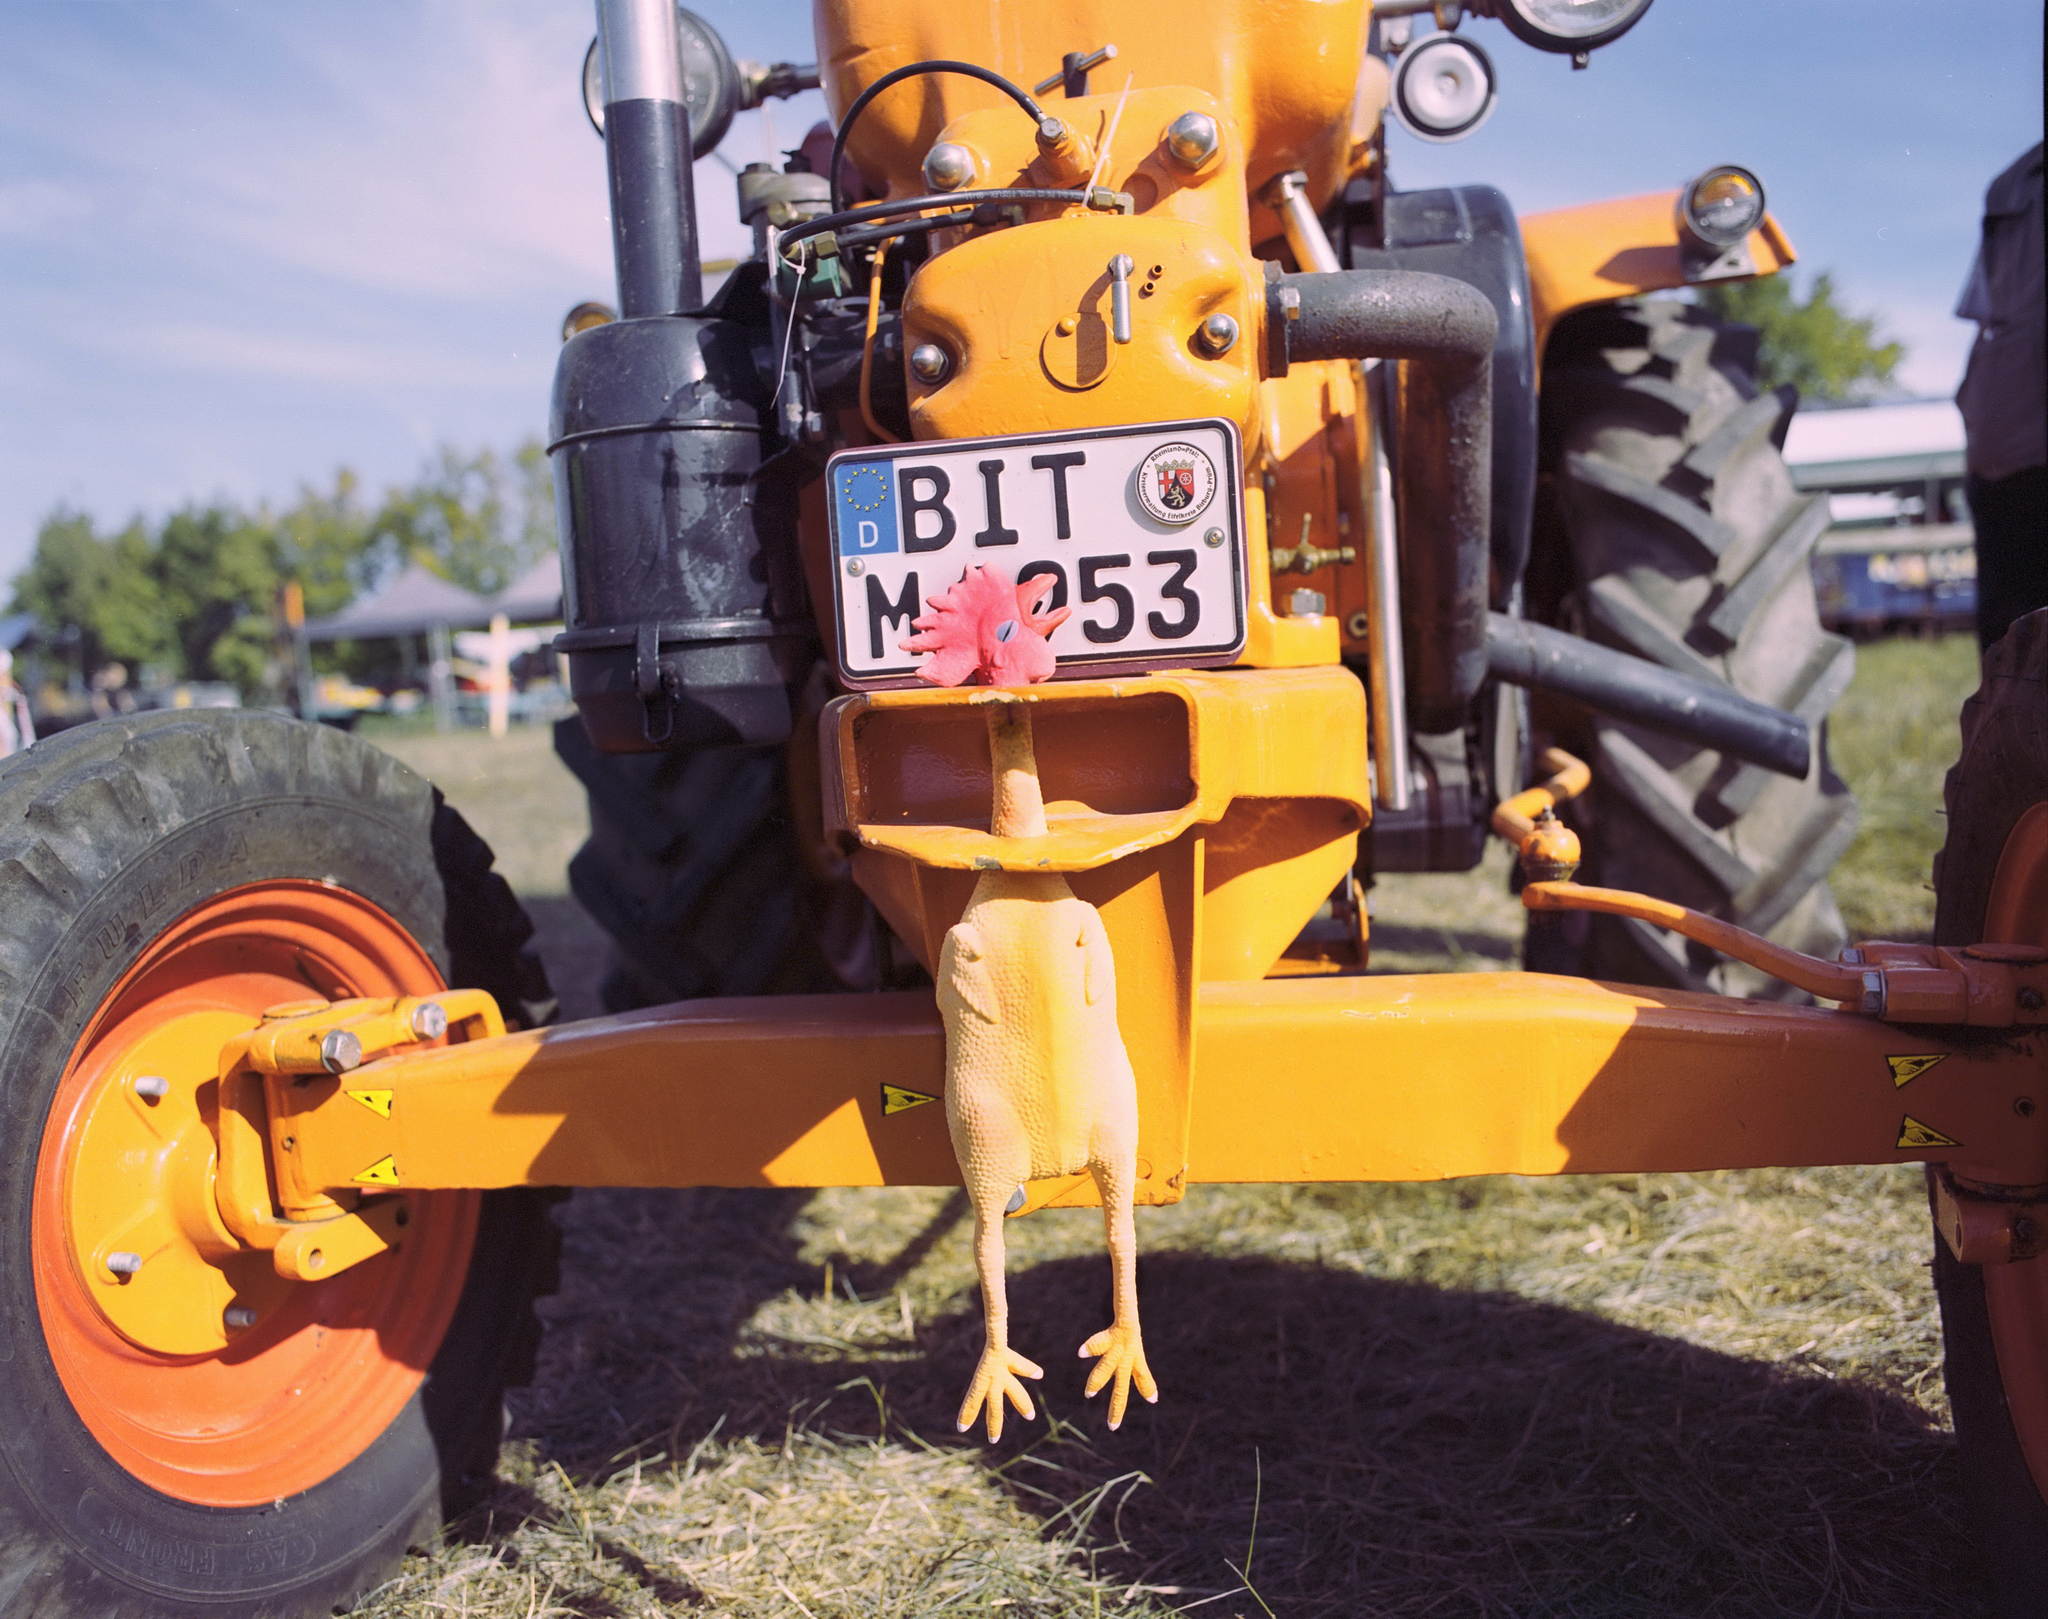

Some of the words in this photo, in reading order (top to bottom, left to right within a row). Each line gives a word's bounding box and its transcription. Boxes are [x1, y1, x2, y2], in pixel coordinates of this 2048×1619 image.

[859, 521, 879, 548] D
[899, 451, 1086, 553] BIT
[61, 831, 248, 1008] FULDA
